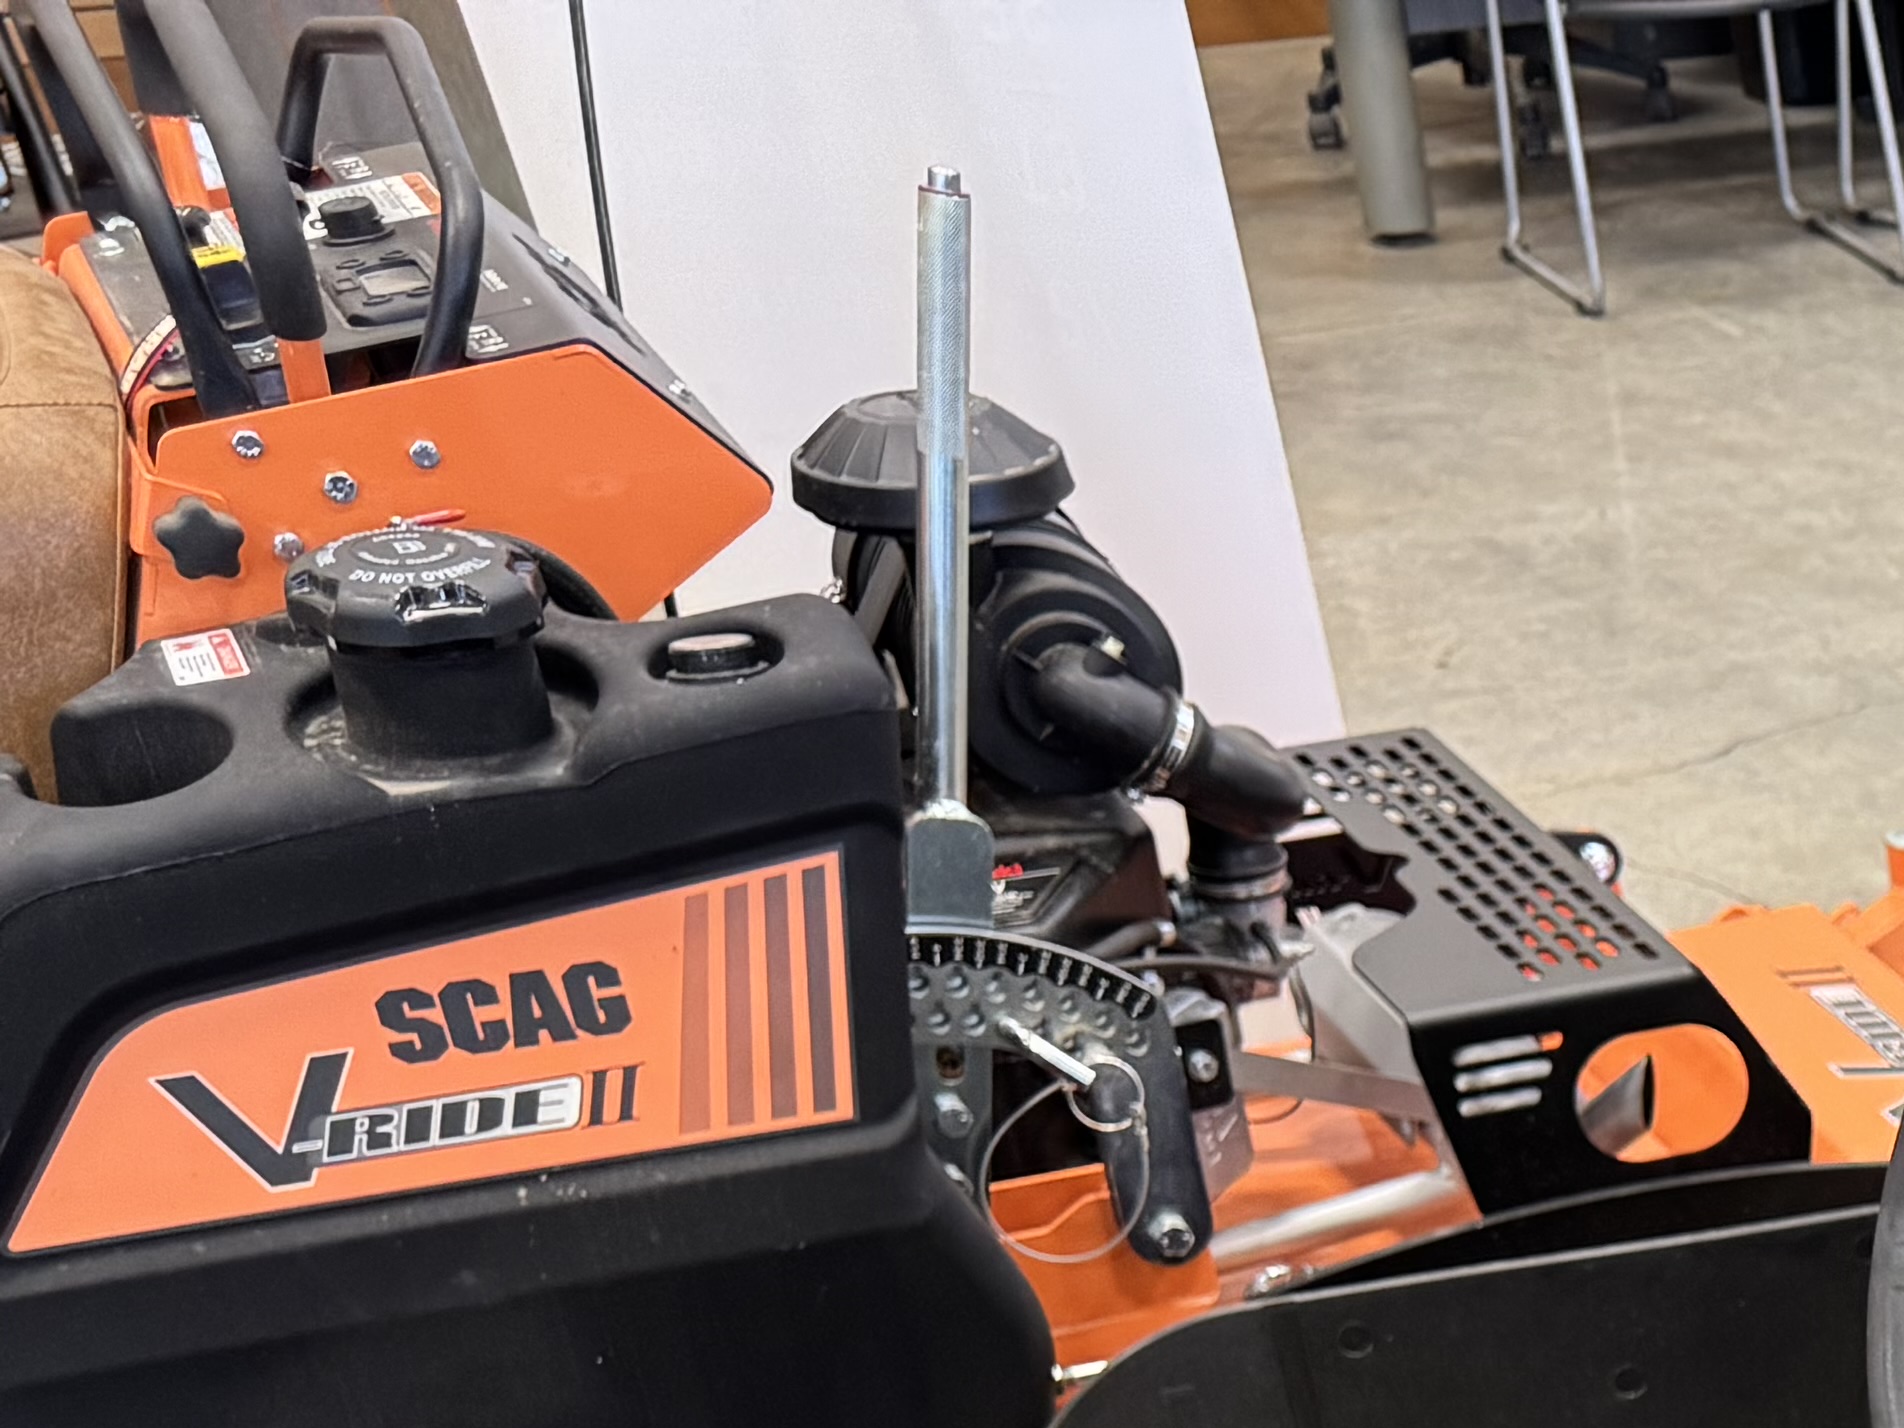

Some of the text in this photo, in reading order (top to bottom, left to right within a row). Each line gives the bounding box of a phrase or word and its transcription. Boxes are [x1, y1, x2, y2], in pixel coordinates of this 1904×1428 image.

[348, 569, 376, 583] DO
[378, 571, 416, 585] NOT
[373, 960, 633, 1067] SCAG
